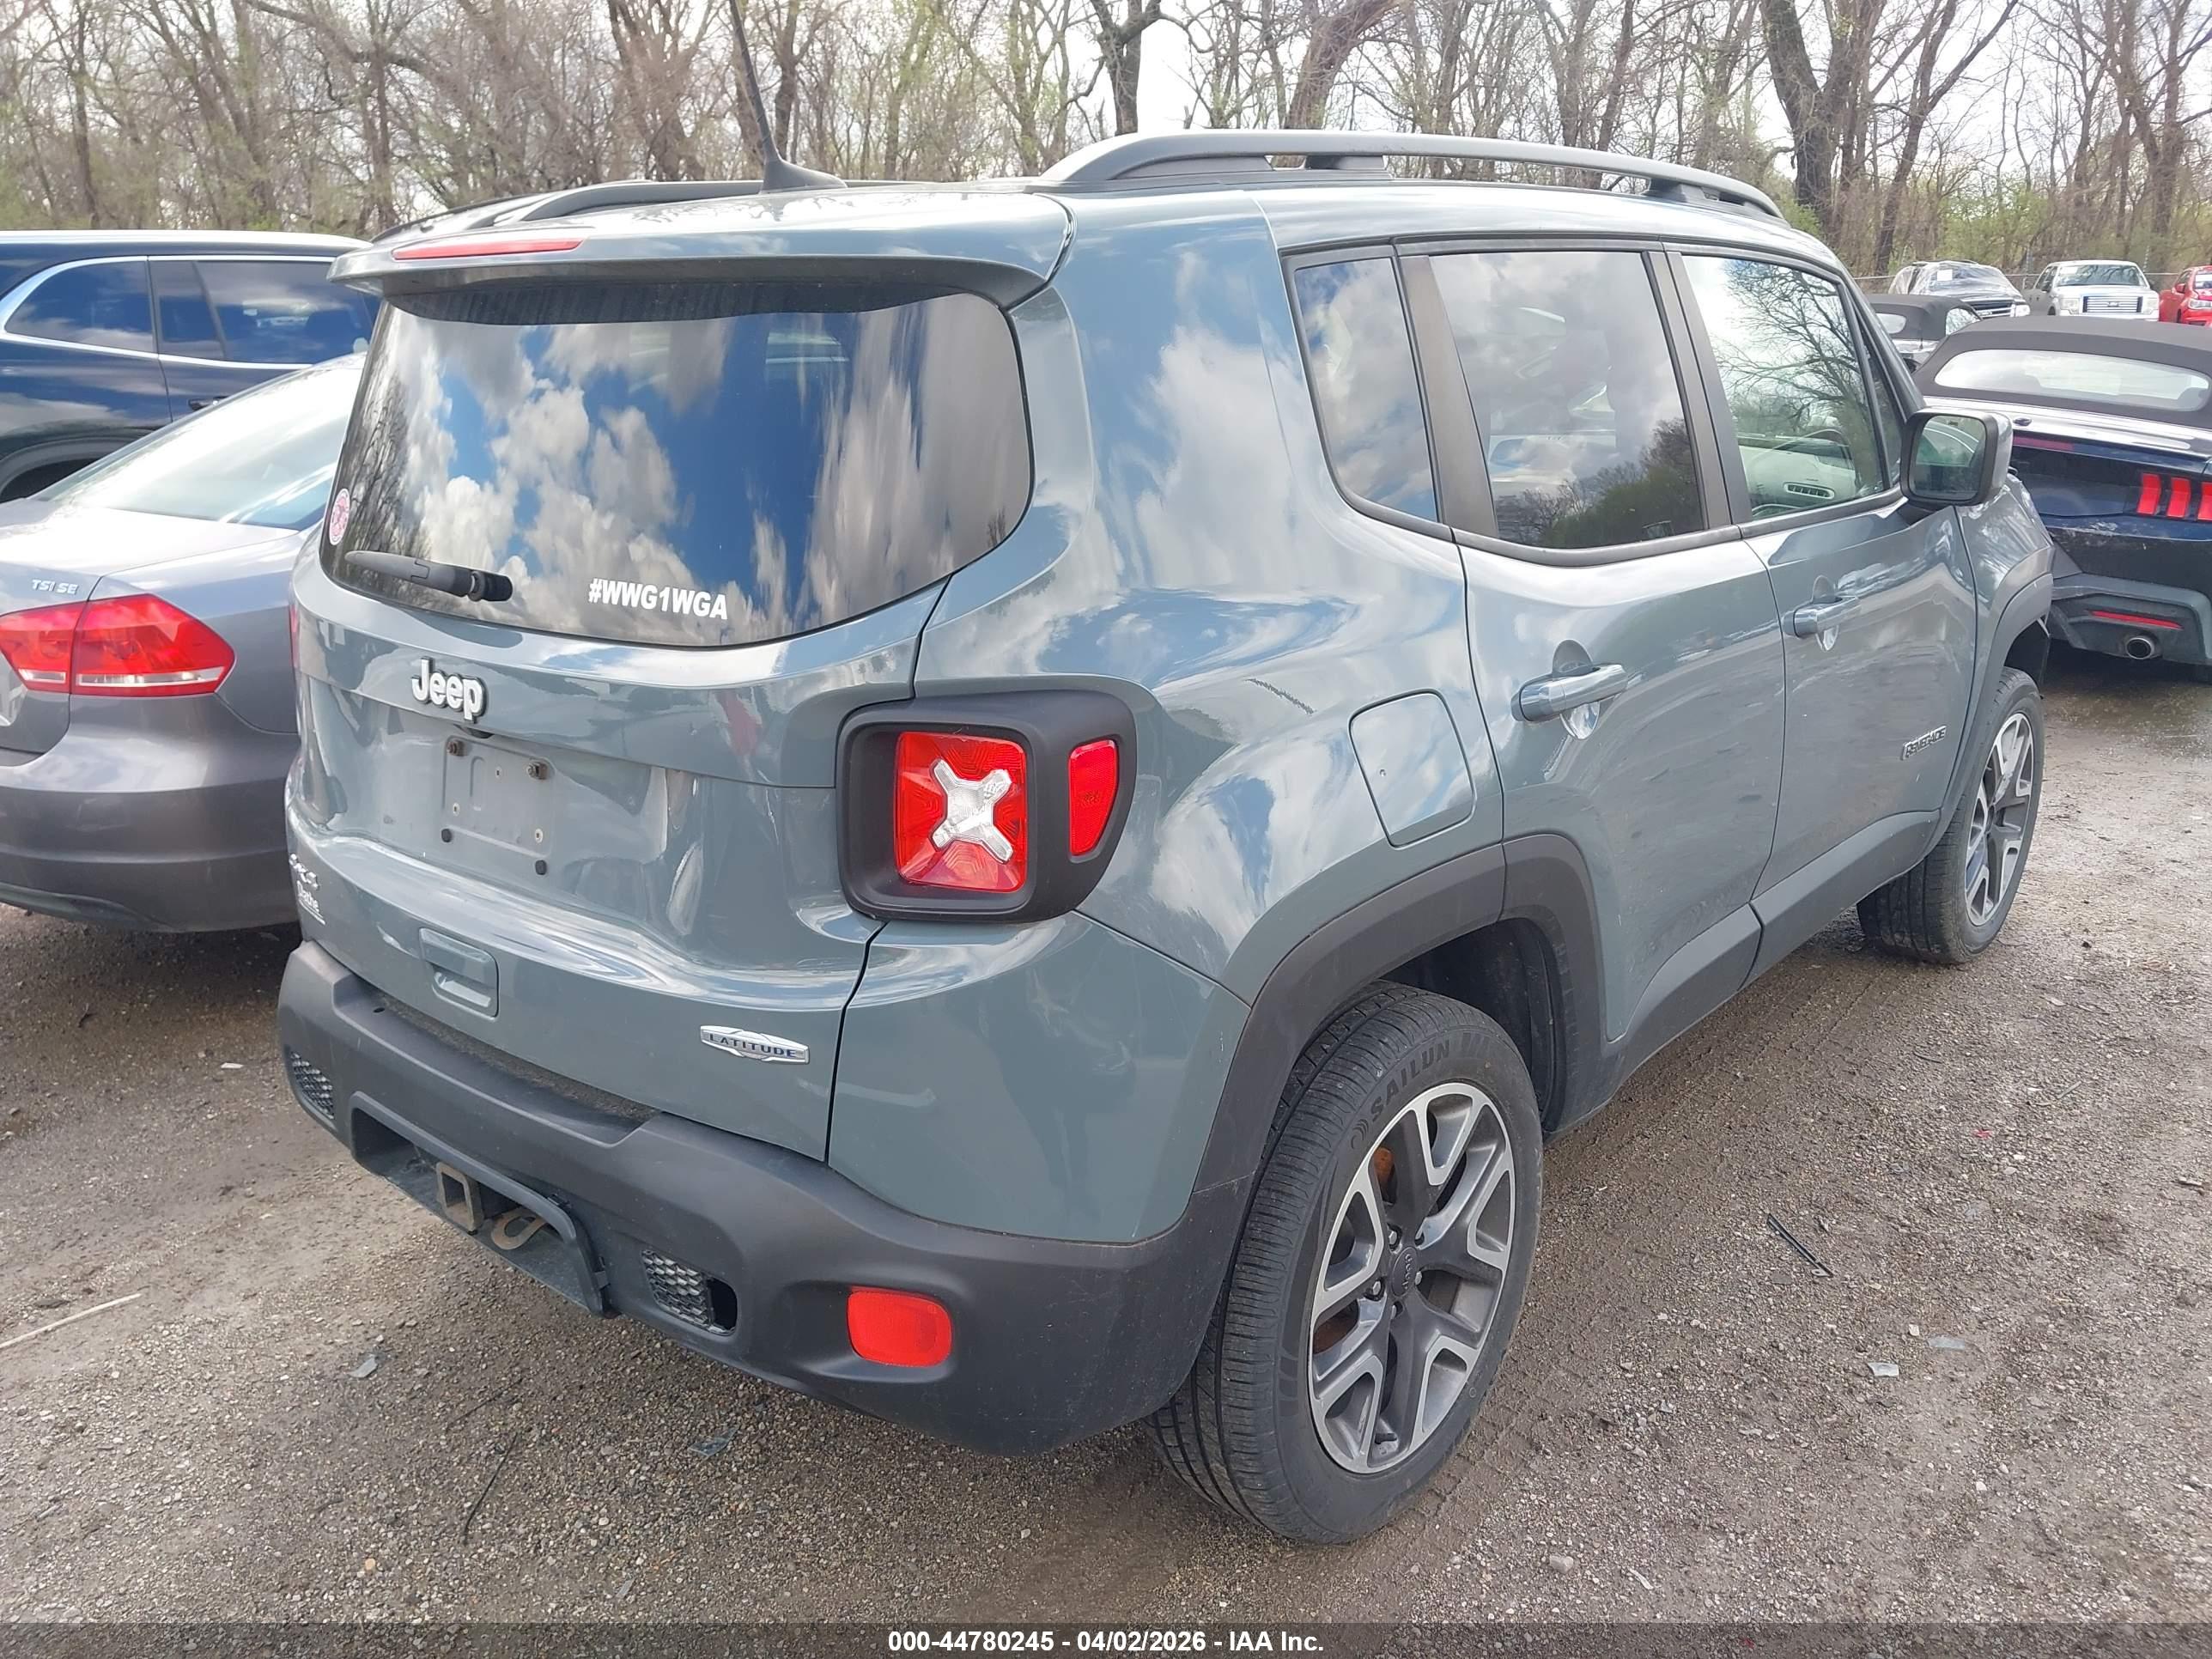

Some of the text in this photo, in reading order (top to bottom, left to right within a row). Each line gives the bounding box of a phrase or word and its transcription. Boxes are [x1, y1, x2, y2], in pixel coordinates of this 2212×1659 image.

[32, 579, 79, 595] TSI SE
[587, 578, 728, 620] #WWG1WGA
[411, 658, 485, 722] Jeep
[709, 1033, 797, 1058] LATITUDE
[1370, 1040, 1450, 1121] SAILUN
